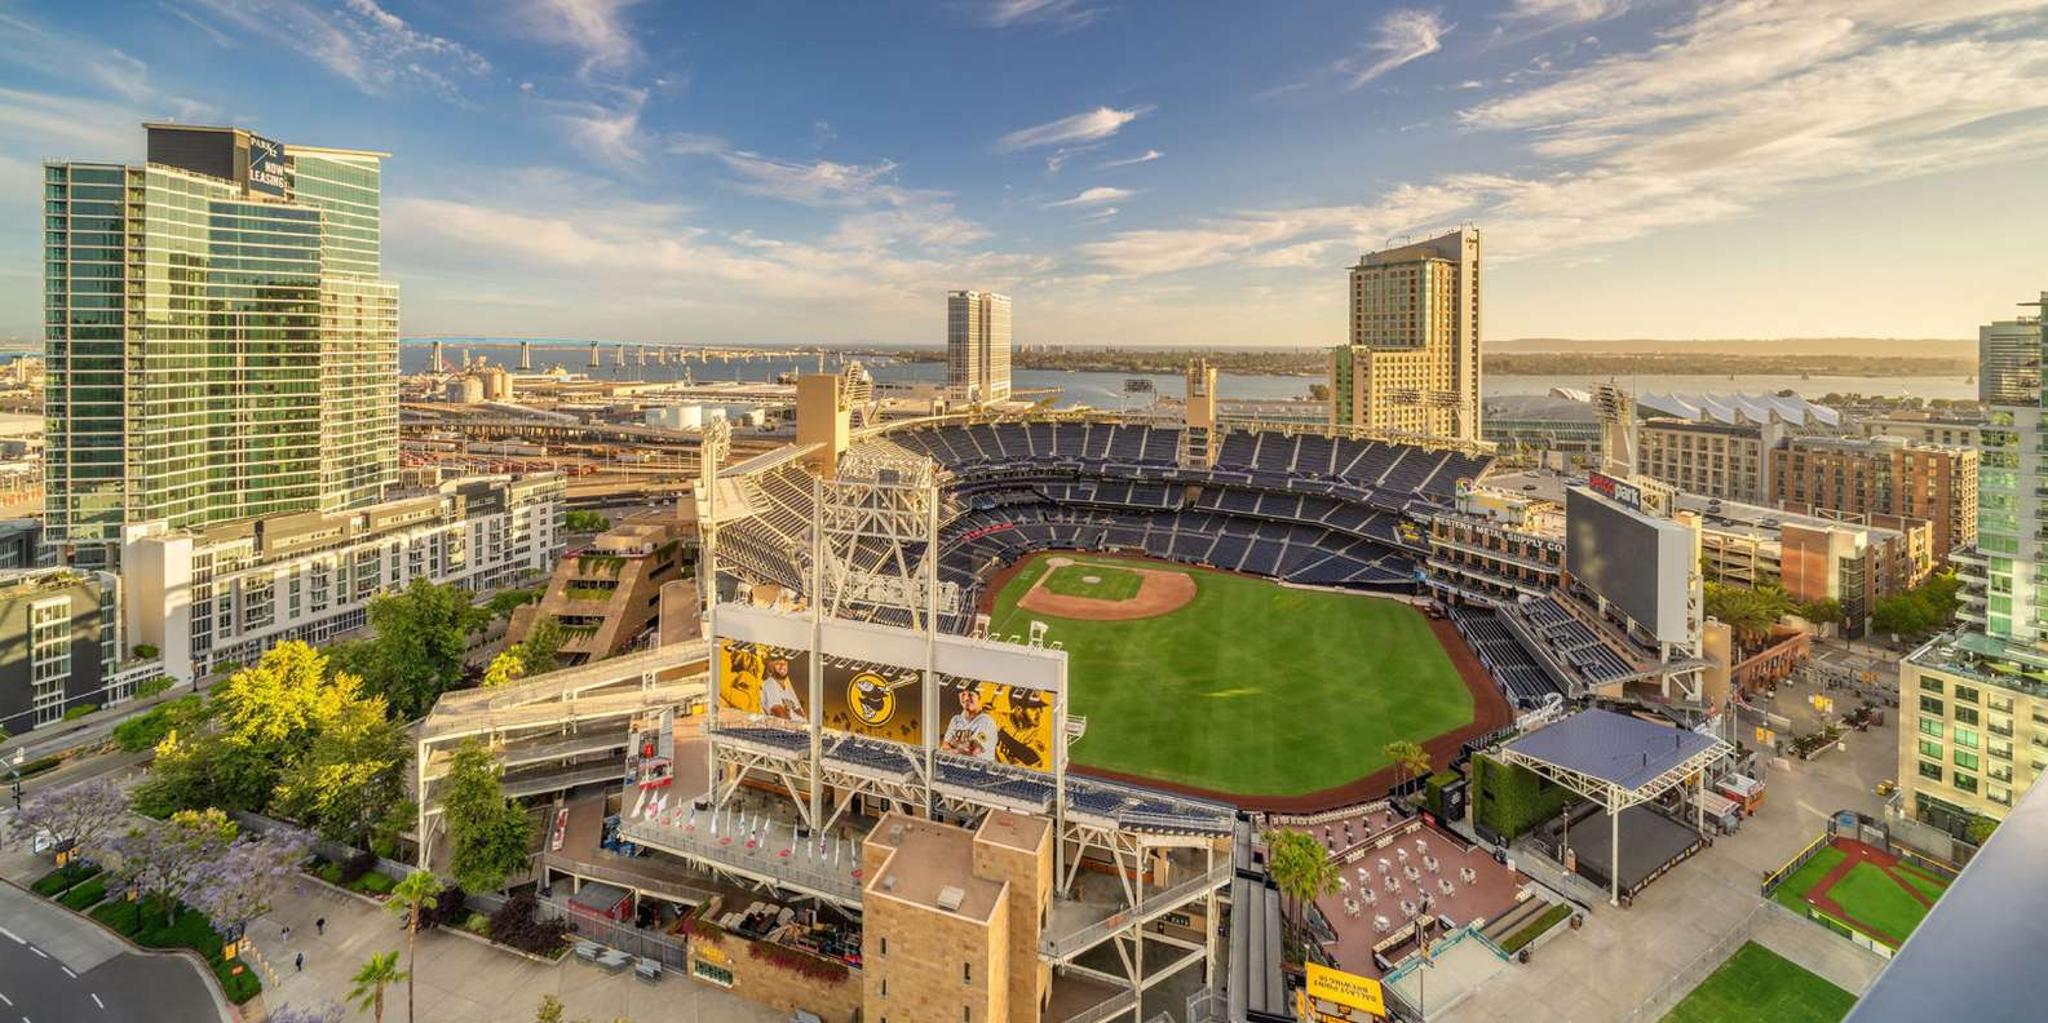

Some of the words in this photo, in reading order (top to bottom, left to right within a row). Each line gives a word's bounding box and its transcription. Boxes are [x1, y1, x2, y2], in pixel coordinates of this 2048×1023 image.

[265, 161, 284, 176] NOW
[250, 169, 284, 188] LEASING
[1476, 525, 1505, 540] METAL
[1507, 533, 1543, 548] SUPPLY
